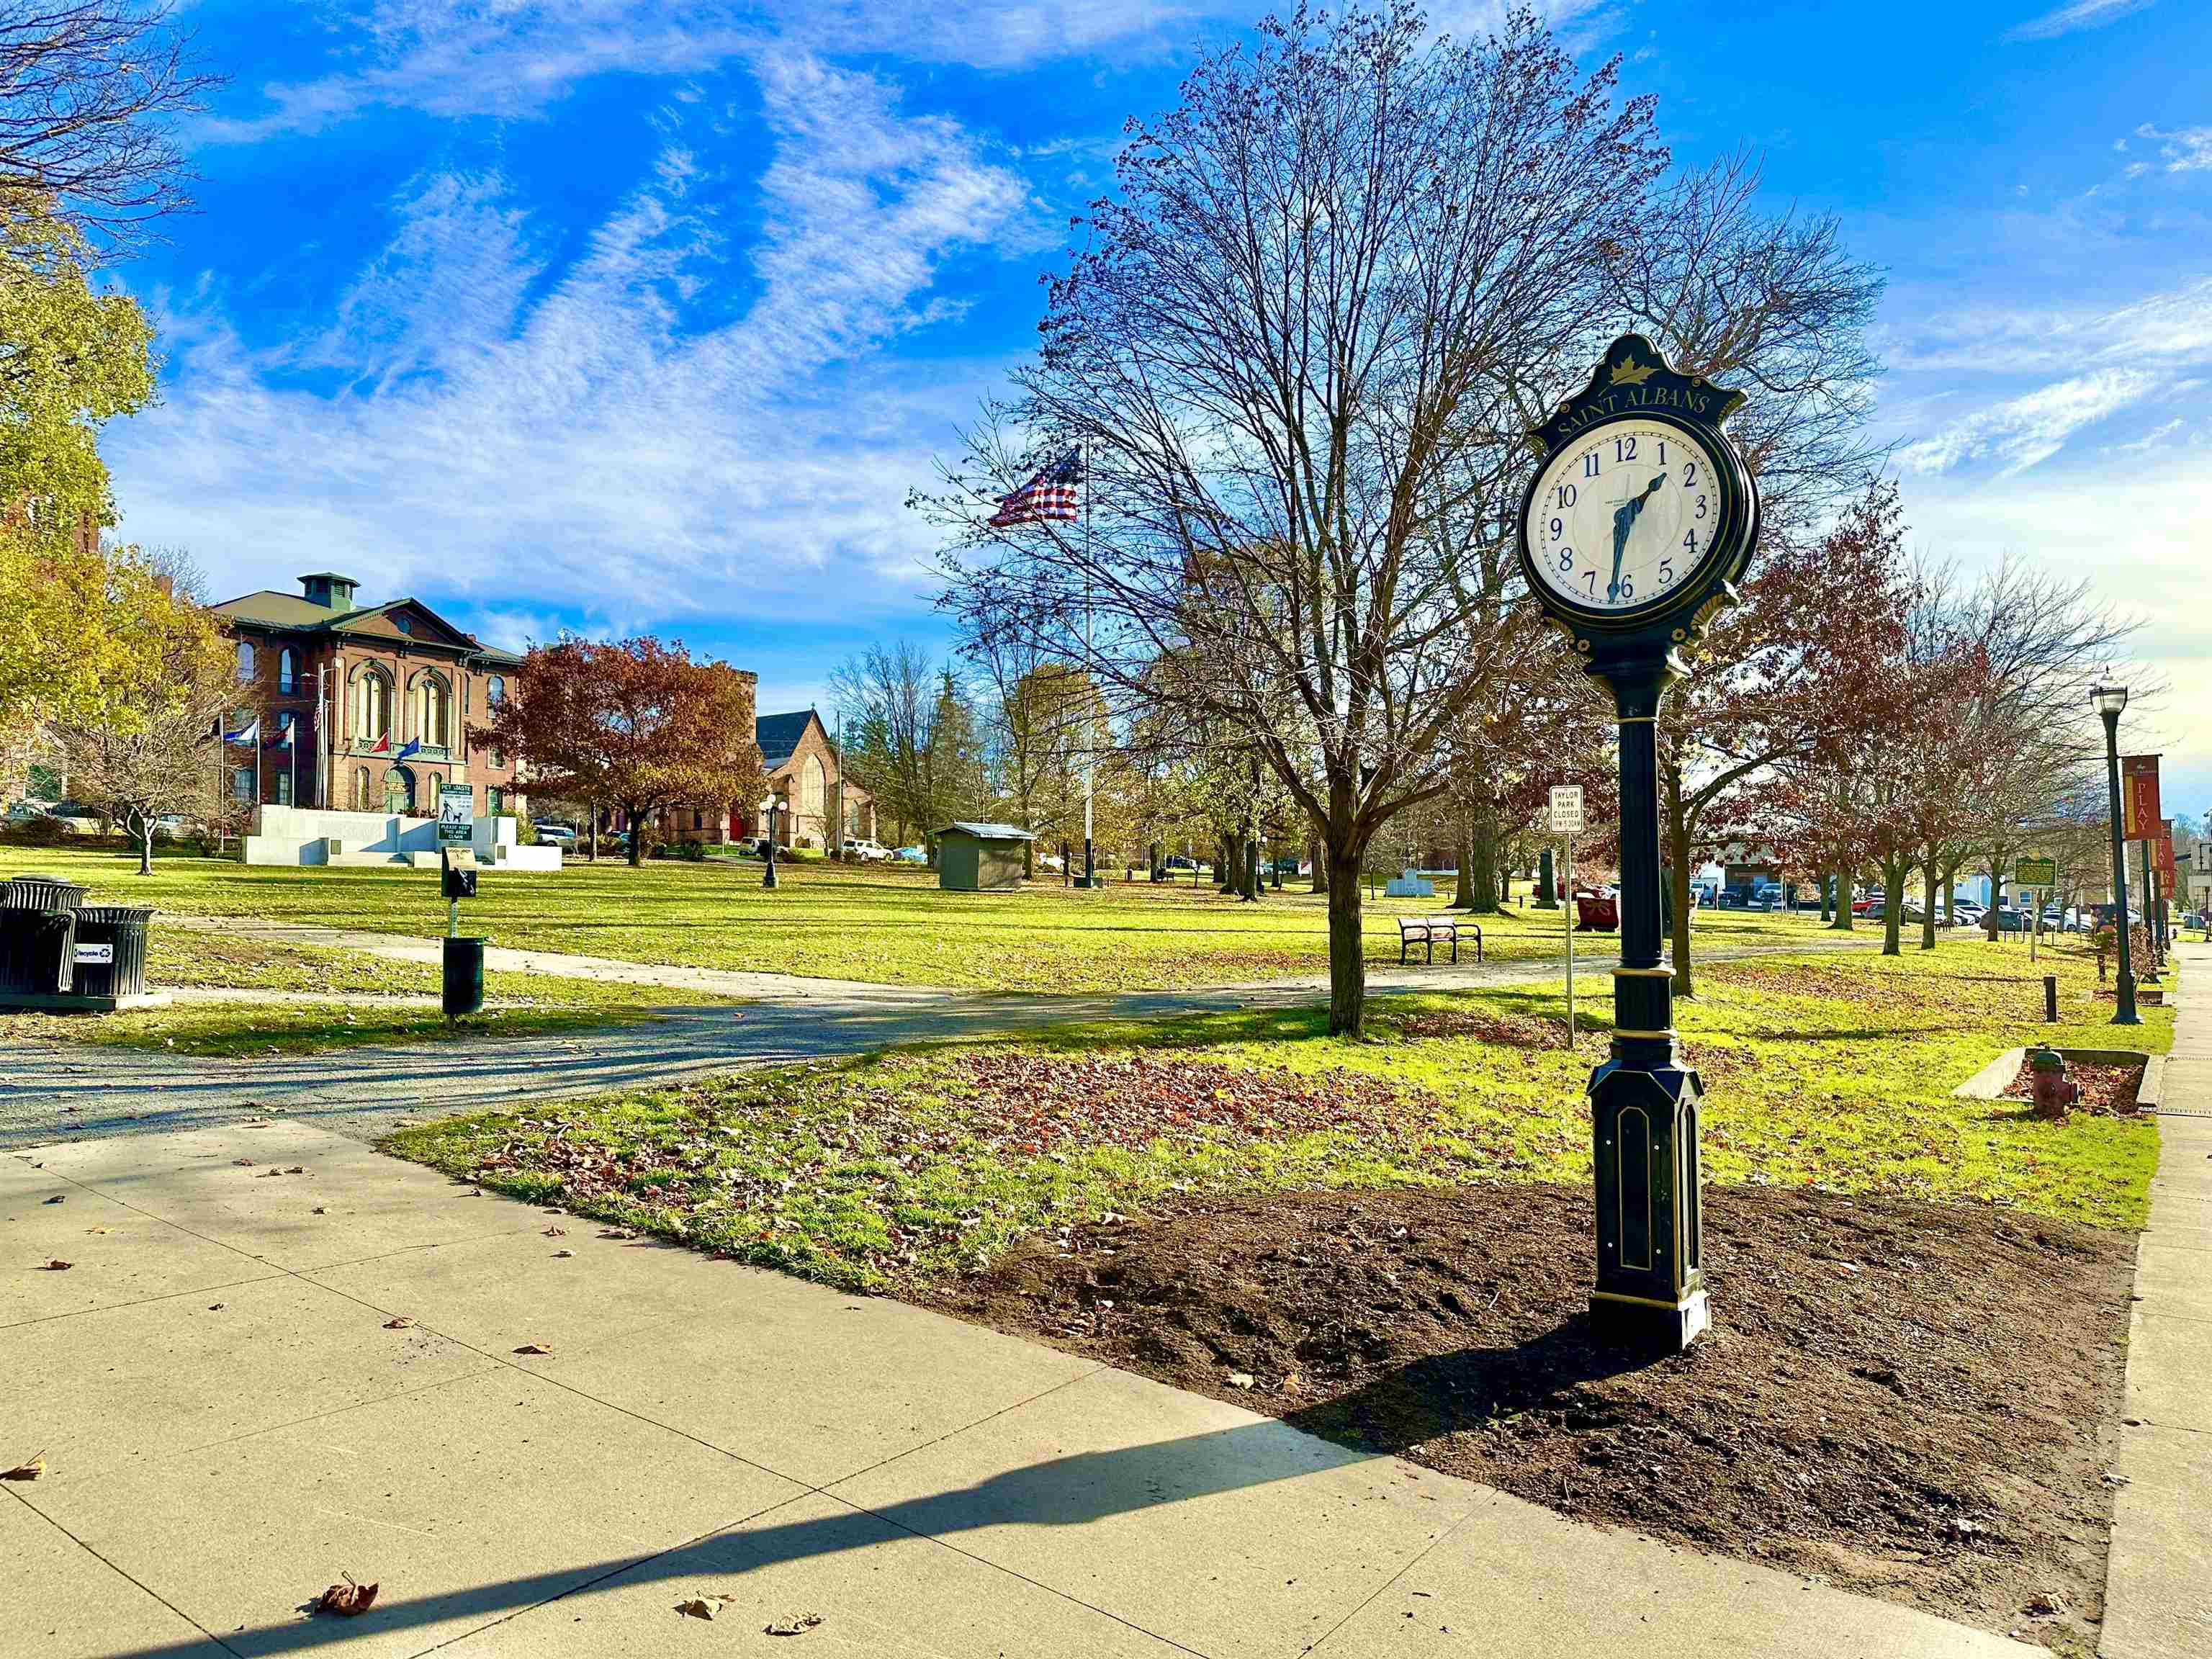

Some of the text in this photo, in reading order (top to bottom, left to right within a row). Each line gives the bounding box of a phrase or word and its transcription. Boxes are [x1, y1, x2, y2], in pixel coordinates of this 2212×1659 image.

[1557, 387, 1710, 436] SAINT ALBANS
[1615, 437, 1638, 462] 12
[1658, 441, 1667, 466] 1
[1583, 452, 1601, 478] 11
[1683, 462, 1699, 487] 2
[1556, 484, 1577, 509] 10
[1695, 495, 1707, 519] 3
[1550, 518, 1563, 541] 9
[1683, 529, 1698, 554] 4
[1560, 547, 1573, 571] 8
[1658, 557, 1673, 584] 5
[1581, 570, 1596, 595] 7
[1621, 575, 1633, 598] 6
[2137, 783, 2148, 830] PLAY
